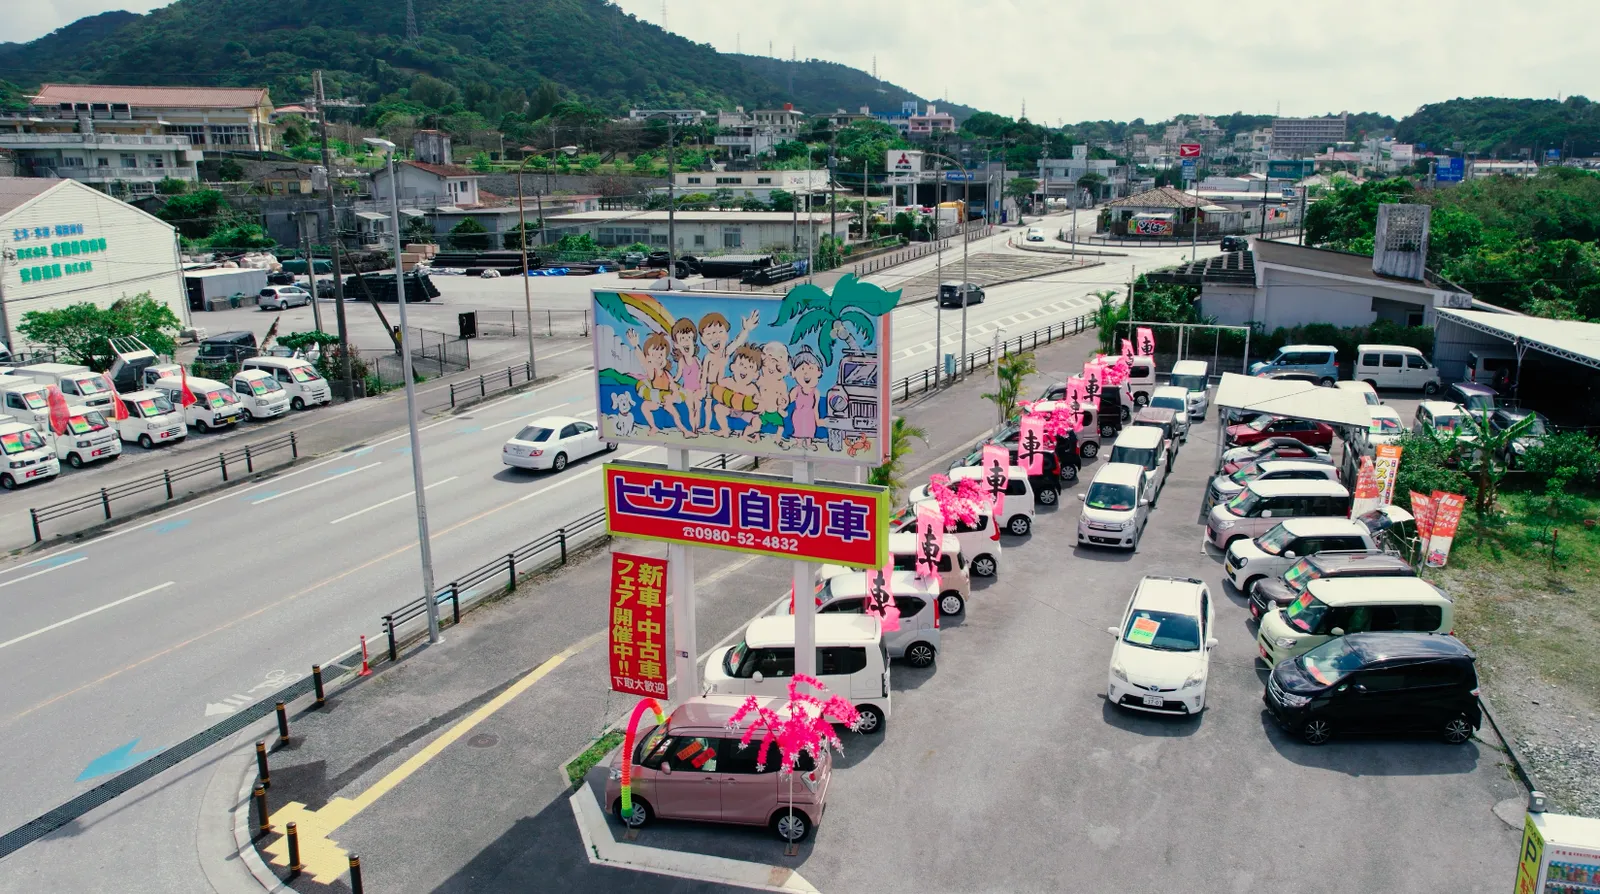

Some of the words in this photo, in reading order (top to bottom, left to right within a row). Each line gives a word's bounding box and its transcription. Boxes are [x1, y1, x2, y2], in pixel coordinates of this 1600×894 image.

[1070, 389, 1085, 423] 車
[1083, 373, 1102, 402] 車
[1019, 429, 1044, 467] 車
[987, 459, 1008, 504] 車
[614, 476, 871, 542] ヒサシ自動車
[695, 526, 799, 551] 0980-52-4832
[918, 523, 940, 574] 車
[869, 570, 894, 618] 車
[636, 562, 664, 680] 新車・中古車
[613, 676, 666, 695] 下取大歓迎
[1524, 836, 1537, 863] P
